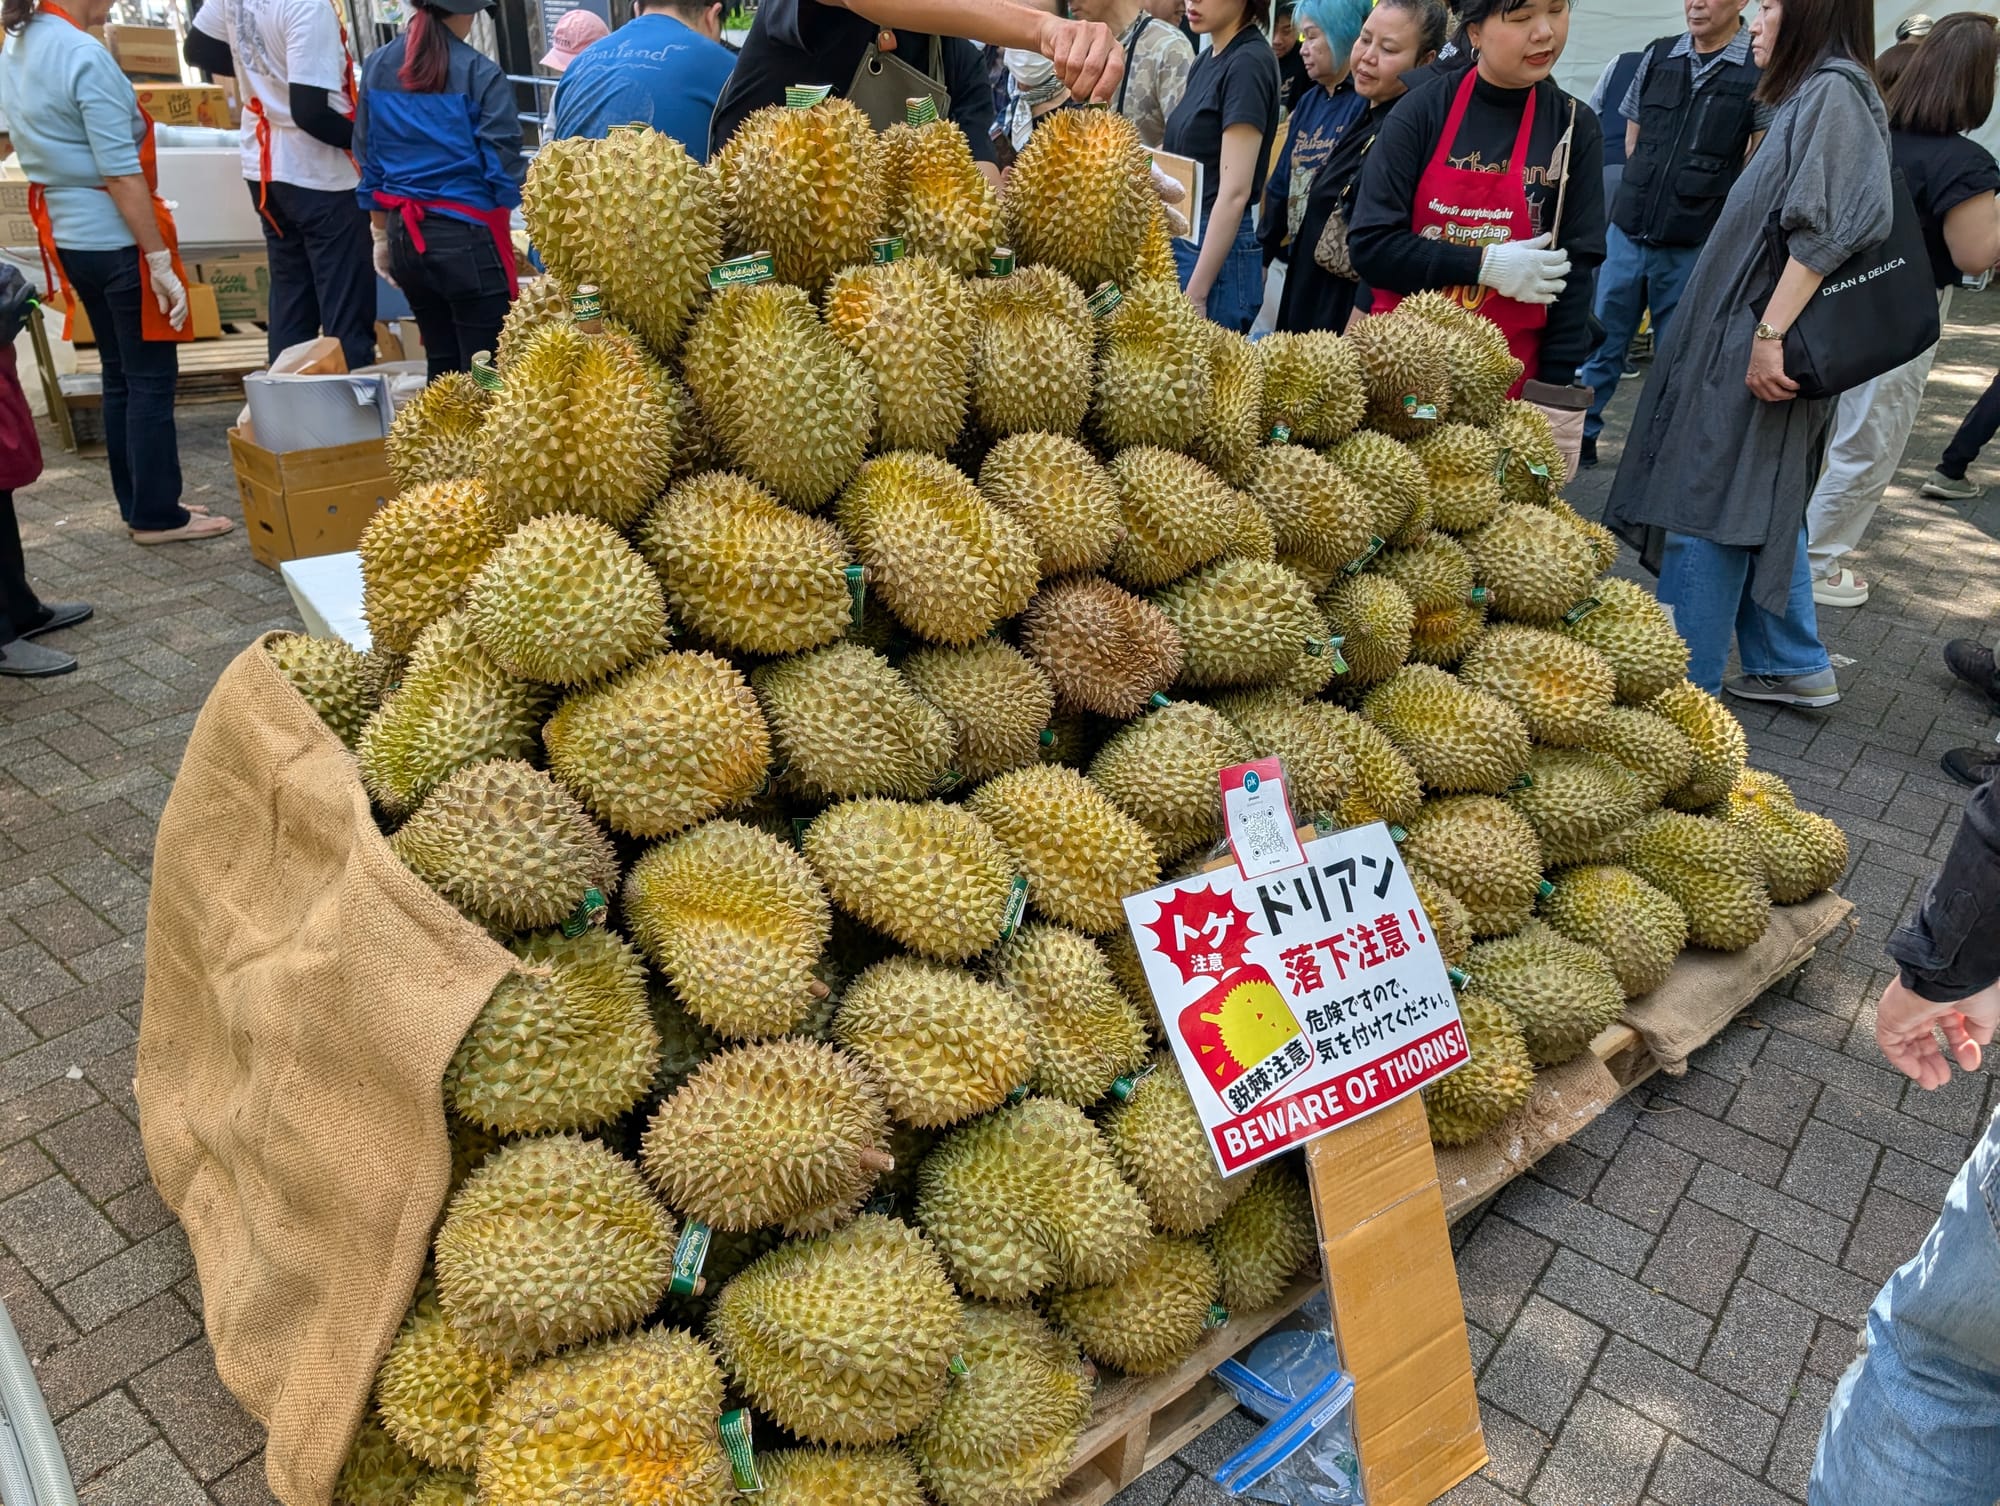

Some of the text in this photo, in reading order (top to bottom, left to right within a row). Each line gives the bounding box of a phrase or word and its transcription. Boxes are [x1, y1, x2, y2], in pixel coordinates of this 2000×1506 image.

[1447, 223, 1509, 242] SuperZaap
[1822, 257, 1906, 297] DEAN & DELUCA
[1246, 775, 1258, 789] pk
[1256, 854, 1395, 937] ドリアン
[1173, 908, 1236, 953] トゲ
[1279, 907, 1428, 998] 落下注意！
[1190, 952, 1225, 973] 注意
[1305, 978, 1408, 1035] 危険ですので、
[1315, 996, 1451, 1064] 気を付けてください。
[1223, 1029, 1464, 1158] BEWARE OF THORNS!
[1228, 1038, 1311, 1114] 鋭棘注意
